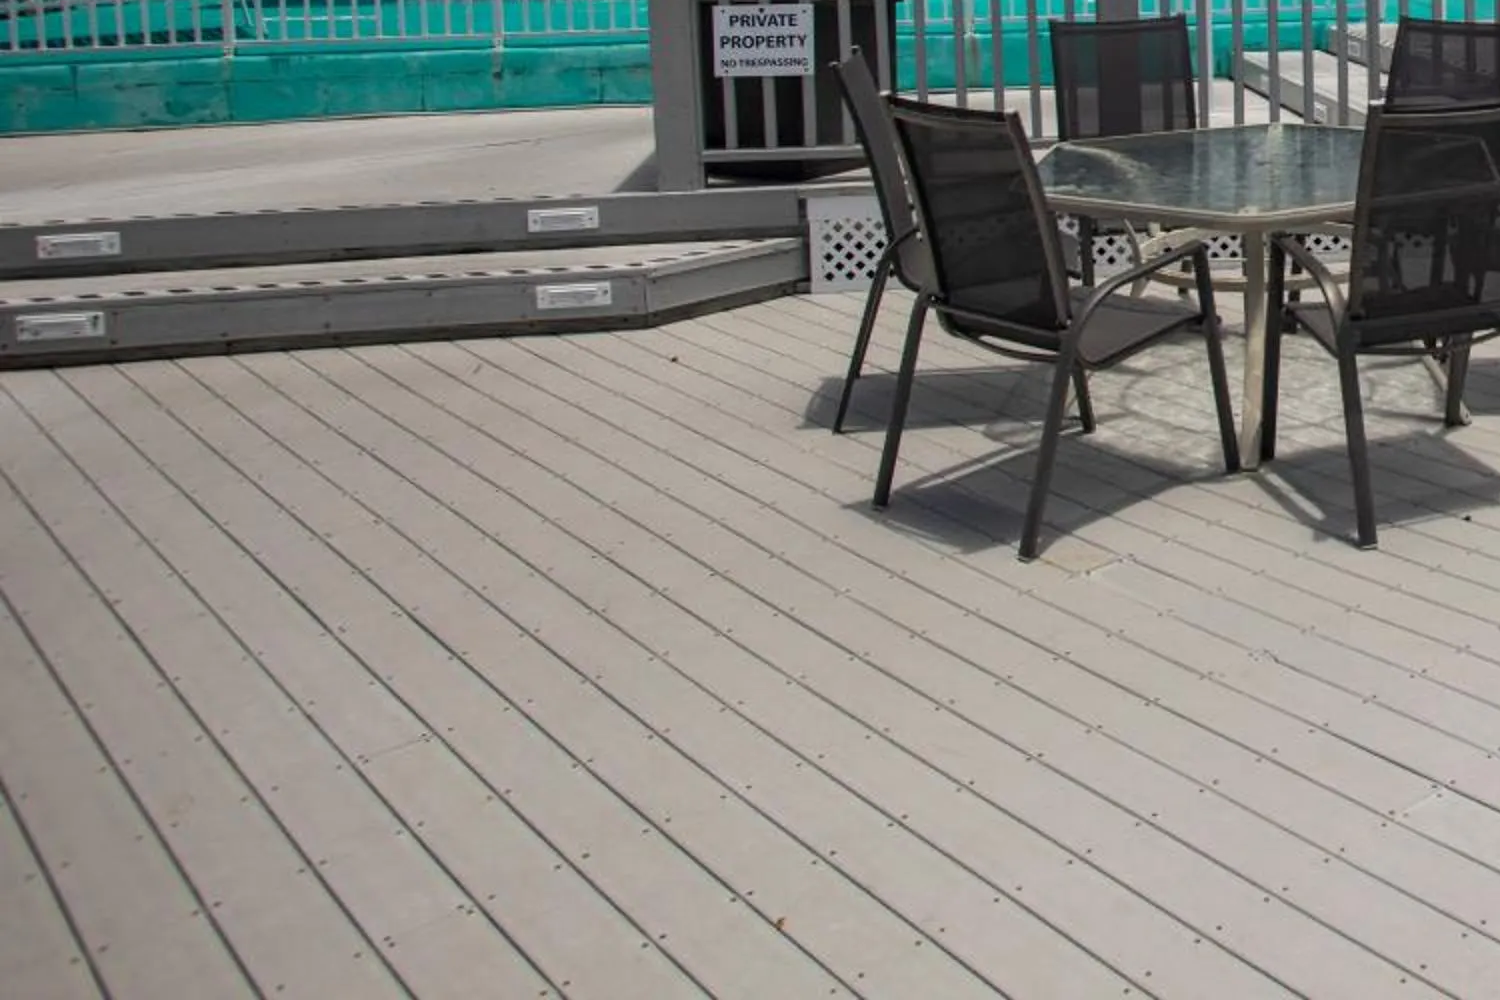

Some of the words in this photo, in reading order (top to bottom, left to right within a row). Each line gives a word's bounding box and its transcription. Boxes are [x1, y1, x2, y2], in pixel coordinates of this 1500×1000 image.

[729, 13, 799, 28] PRIVATE
[720, 34, 807, 49] PROPERTY
[721, 59, 736, 69] NO
[740, 57, 809, 67] TRESPASSING
